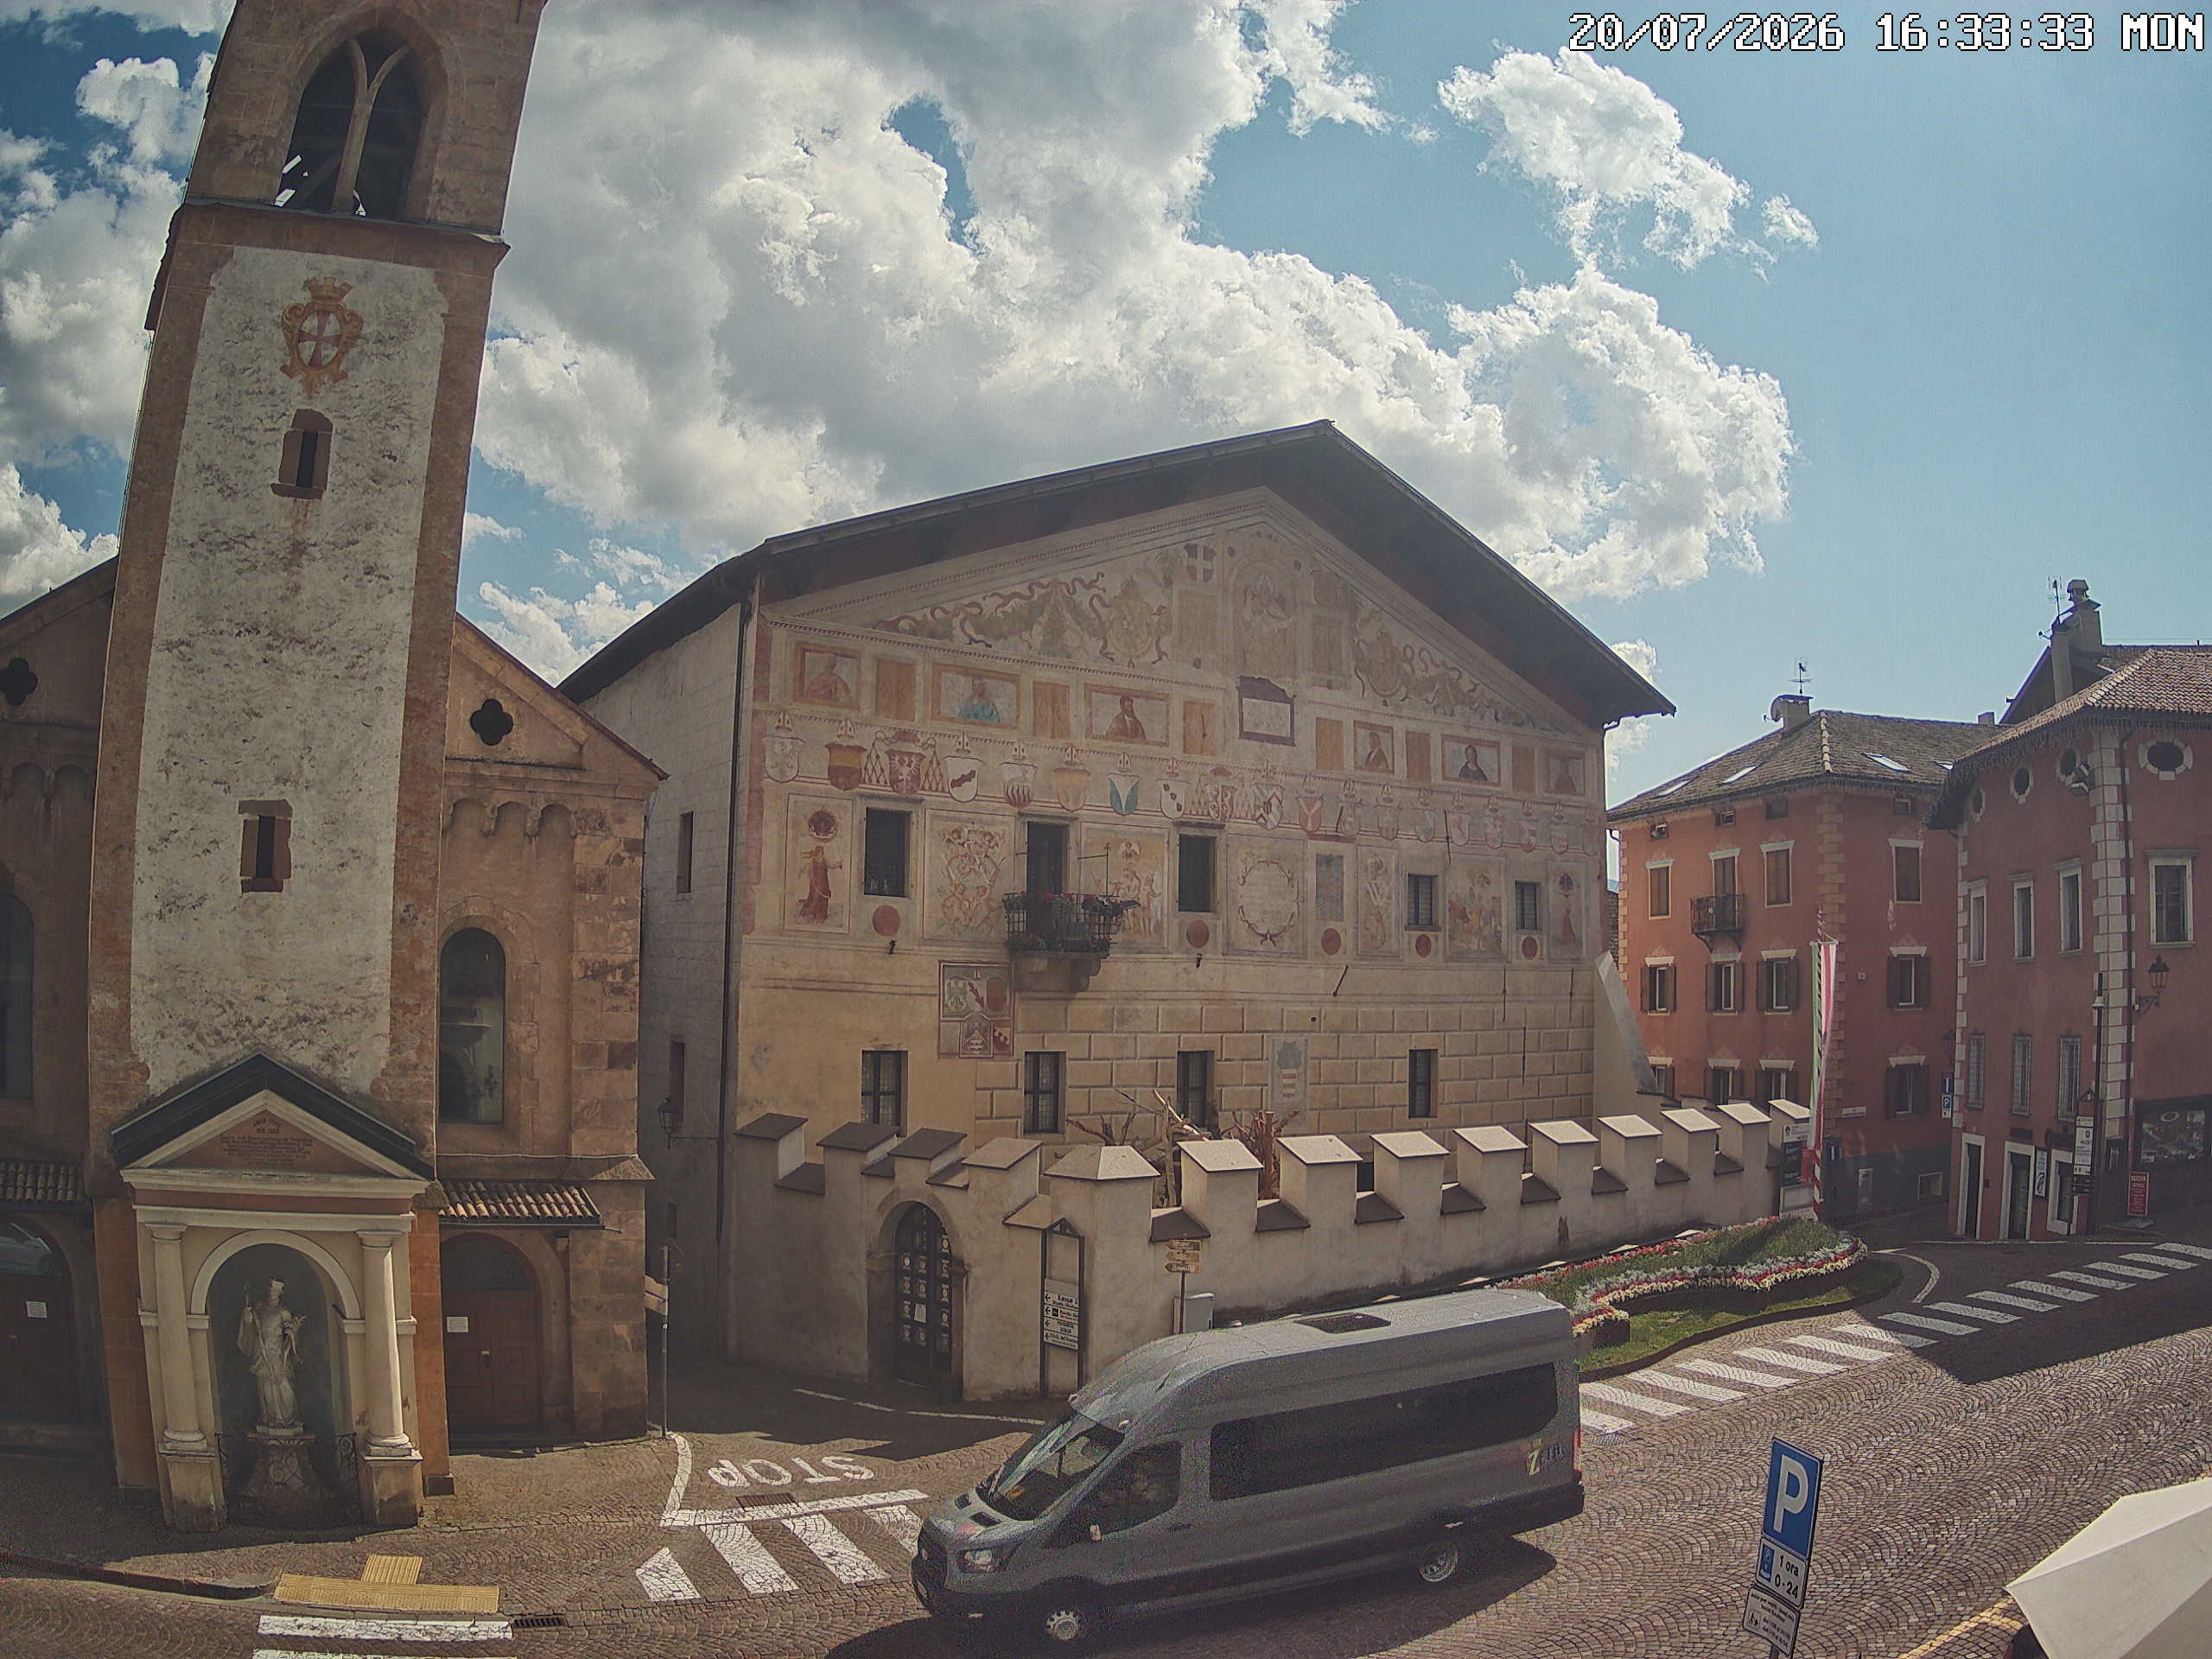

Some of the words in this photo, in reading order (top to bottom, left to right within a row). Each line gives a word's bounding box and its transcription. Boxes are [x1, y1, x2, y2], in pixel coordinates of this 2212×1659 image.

[708, 1456, 874, 1487] STOP
[1773, 1454, 1808, 1533] P
[1779, 1554, 1784, 1567] 1
[1785, 1561, 1799, 1577] ora
